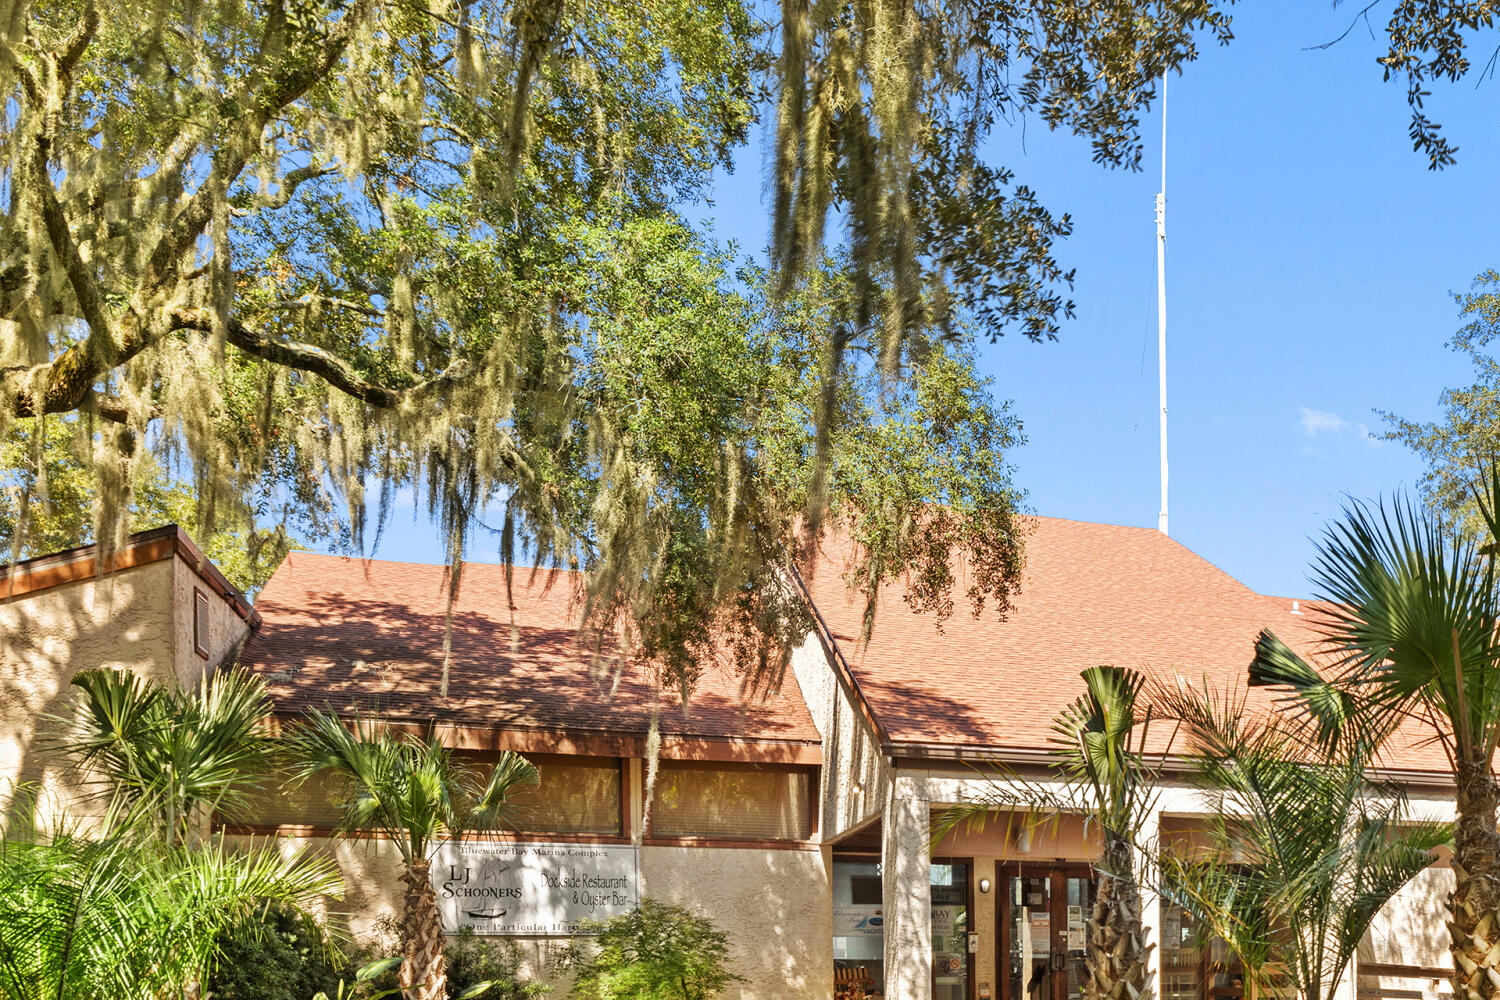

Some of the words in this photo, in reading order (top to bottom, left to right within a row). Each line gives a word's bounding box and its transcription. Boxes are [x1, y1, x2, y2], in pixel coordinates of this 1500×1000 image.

[461, 847, 508, 856] Bluewater
[511, 847, 528, 857] Bay
[532, 848, 565, 857] Marina
[567, 849, 609, 858] Complex
[540, 867, 580, 889] Dockside
[582, 873, 628, 889] Restaurant
[572, 890, 579, 905] &
[581, 890, 611, 914] Oyster
[612, 890, 628, 906] Bar
[494, 922, 548, 931] Particular
